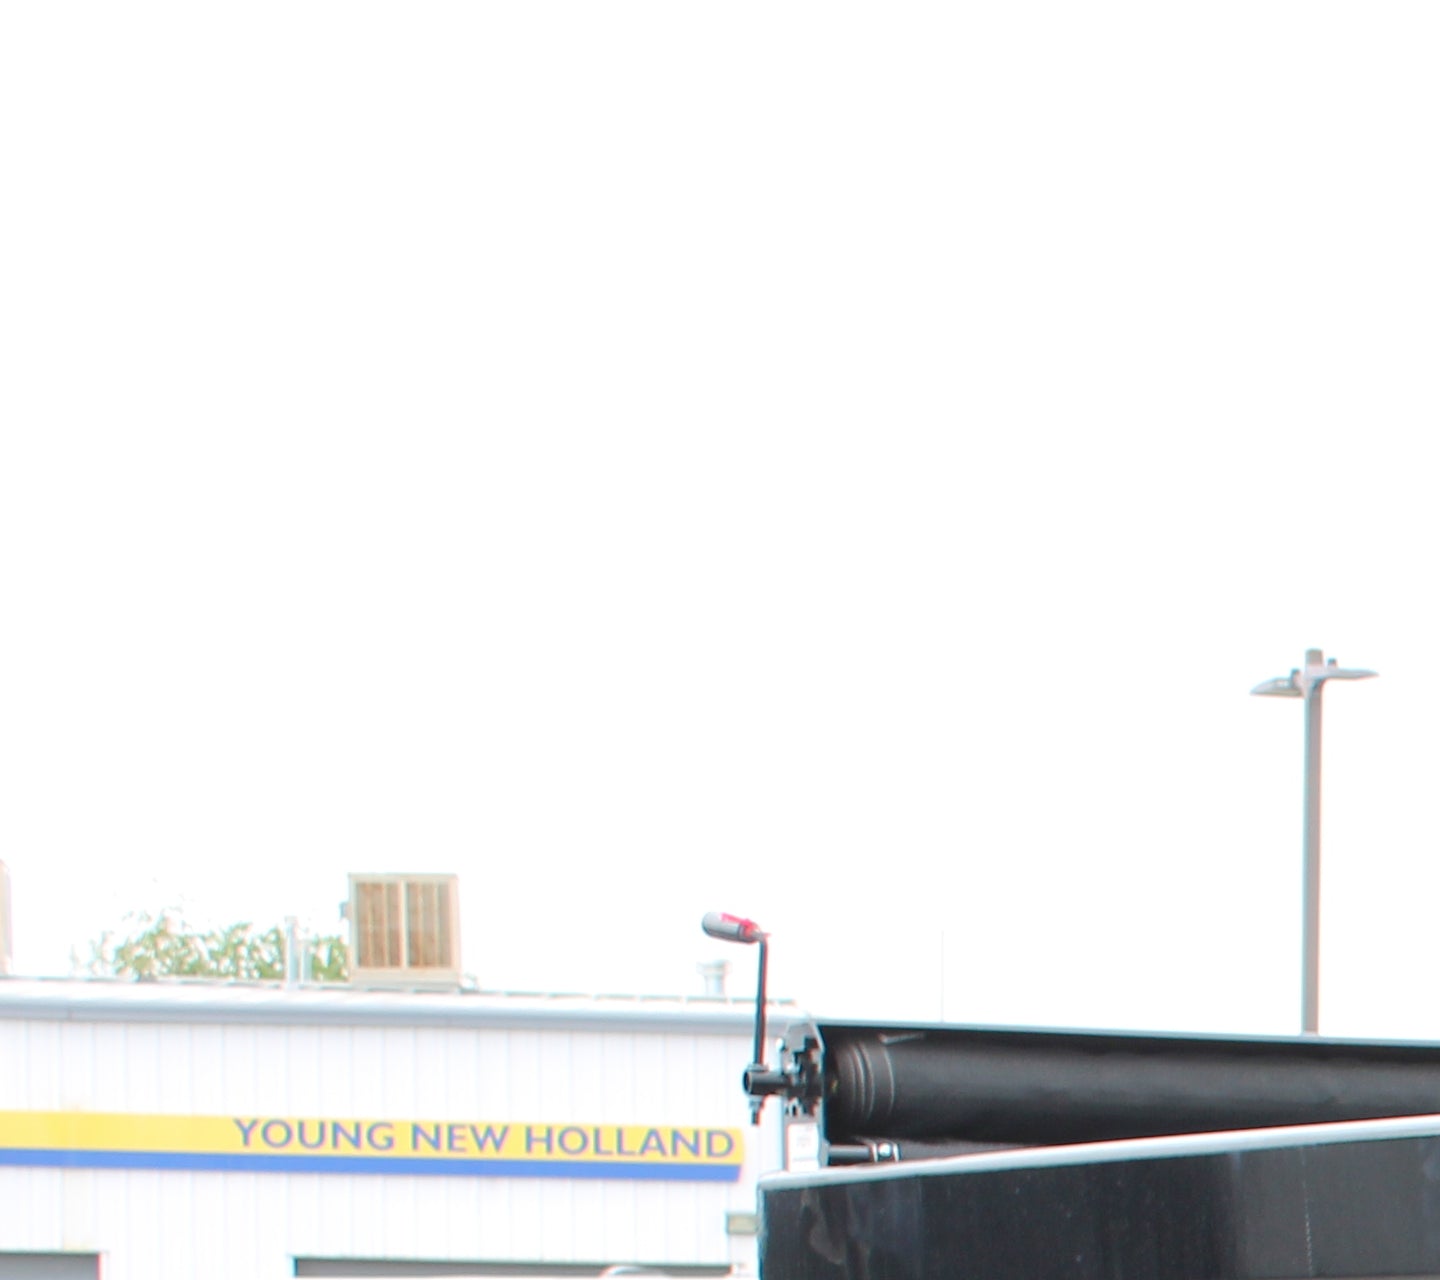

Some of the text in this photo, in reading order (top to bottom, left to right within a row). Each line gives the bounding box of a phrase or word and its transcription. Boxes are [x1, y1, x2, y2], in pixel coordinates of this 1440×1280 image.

[233, 1118, 735, 1158] YOUNG NEW HOLLAND
